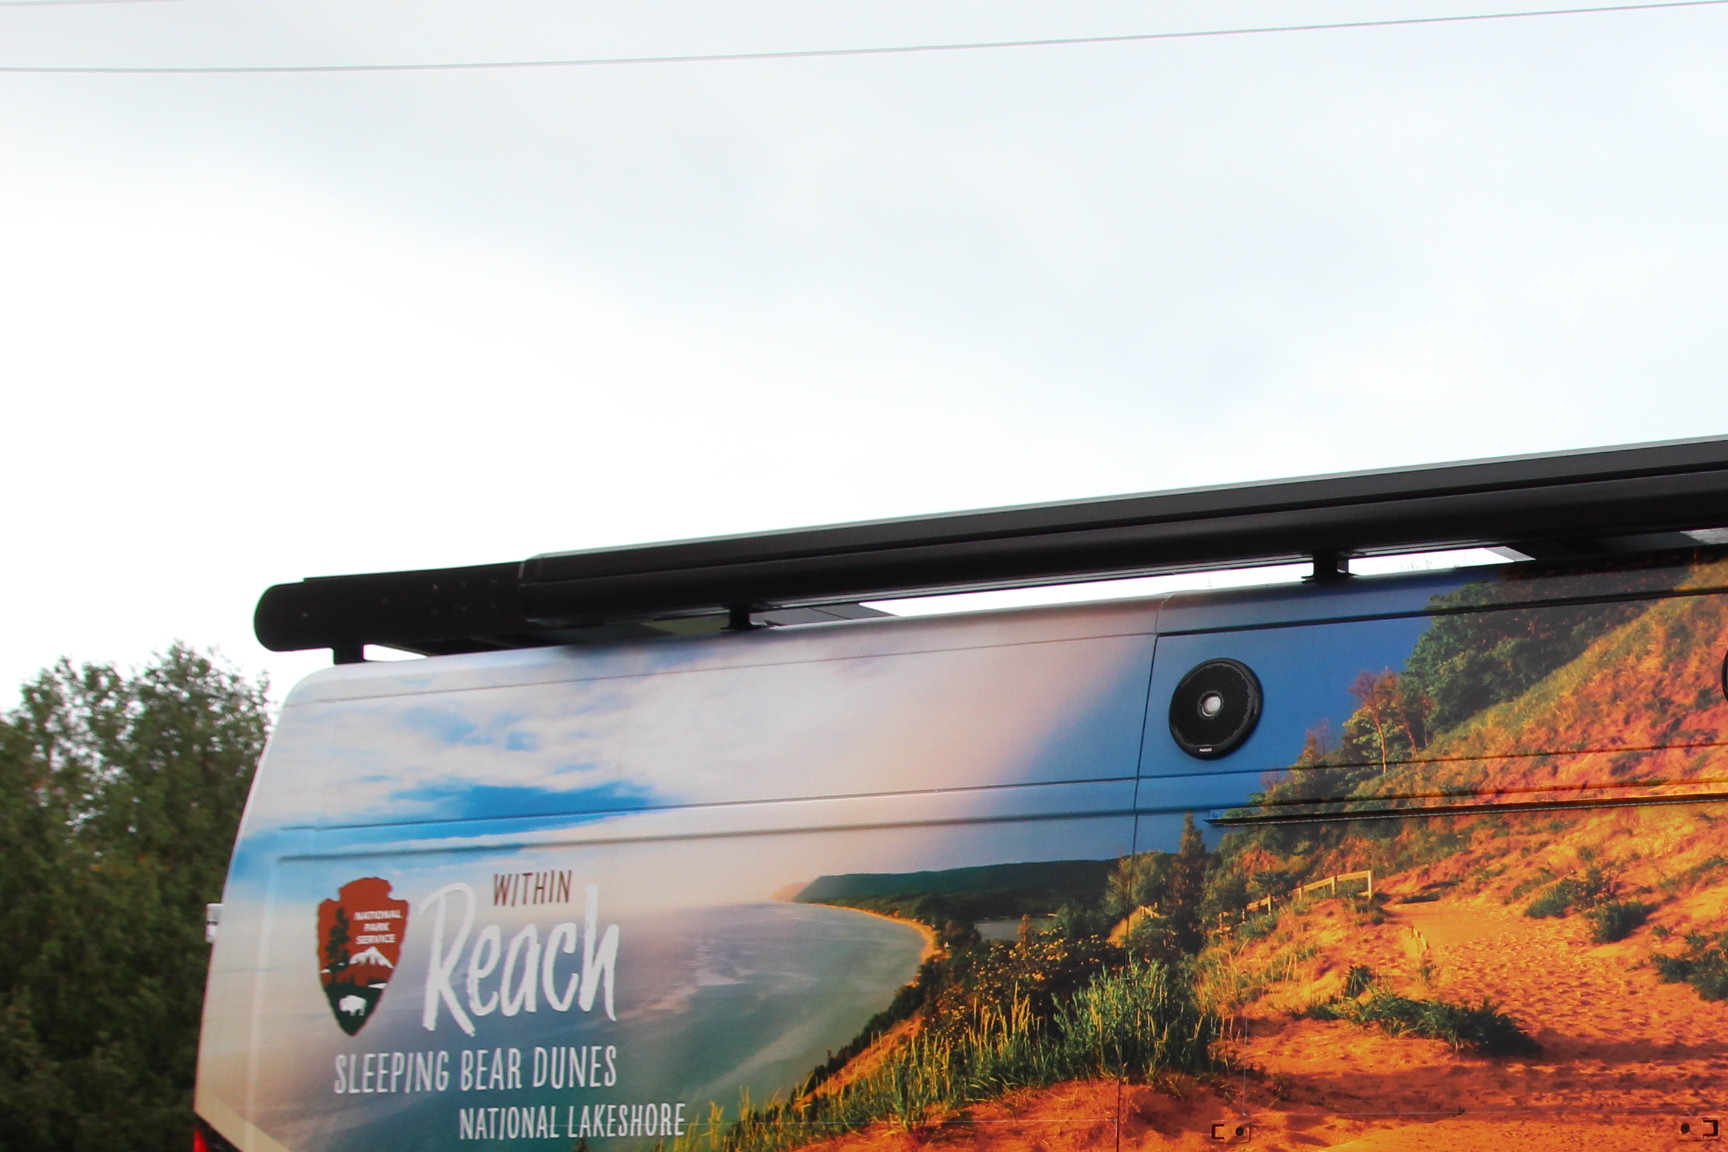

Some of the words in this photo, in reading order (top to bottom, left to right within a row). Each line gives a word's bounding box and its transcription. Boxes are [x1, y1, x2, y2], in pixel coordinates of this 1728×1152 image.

[493, 869, 572, 906] WITHIN
[419, 882, 620, 1037] Reach
[334, 1050, 450, 1094] SLEEPING
[460, 1047, 522, 1091] BEAR
[533, 1045, 617, 1089] DUNES
[459, 1104, 559, 1140] NATIONAL
[567, 1103, 686, 1138] LAKESHORE
